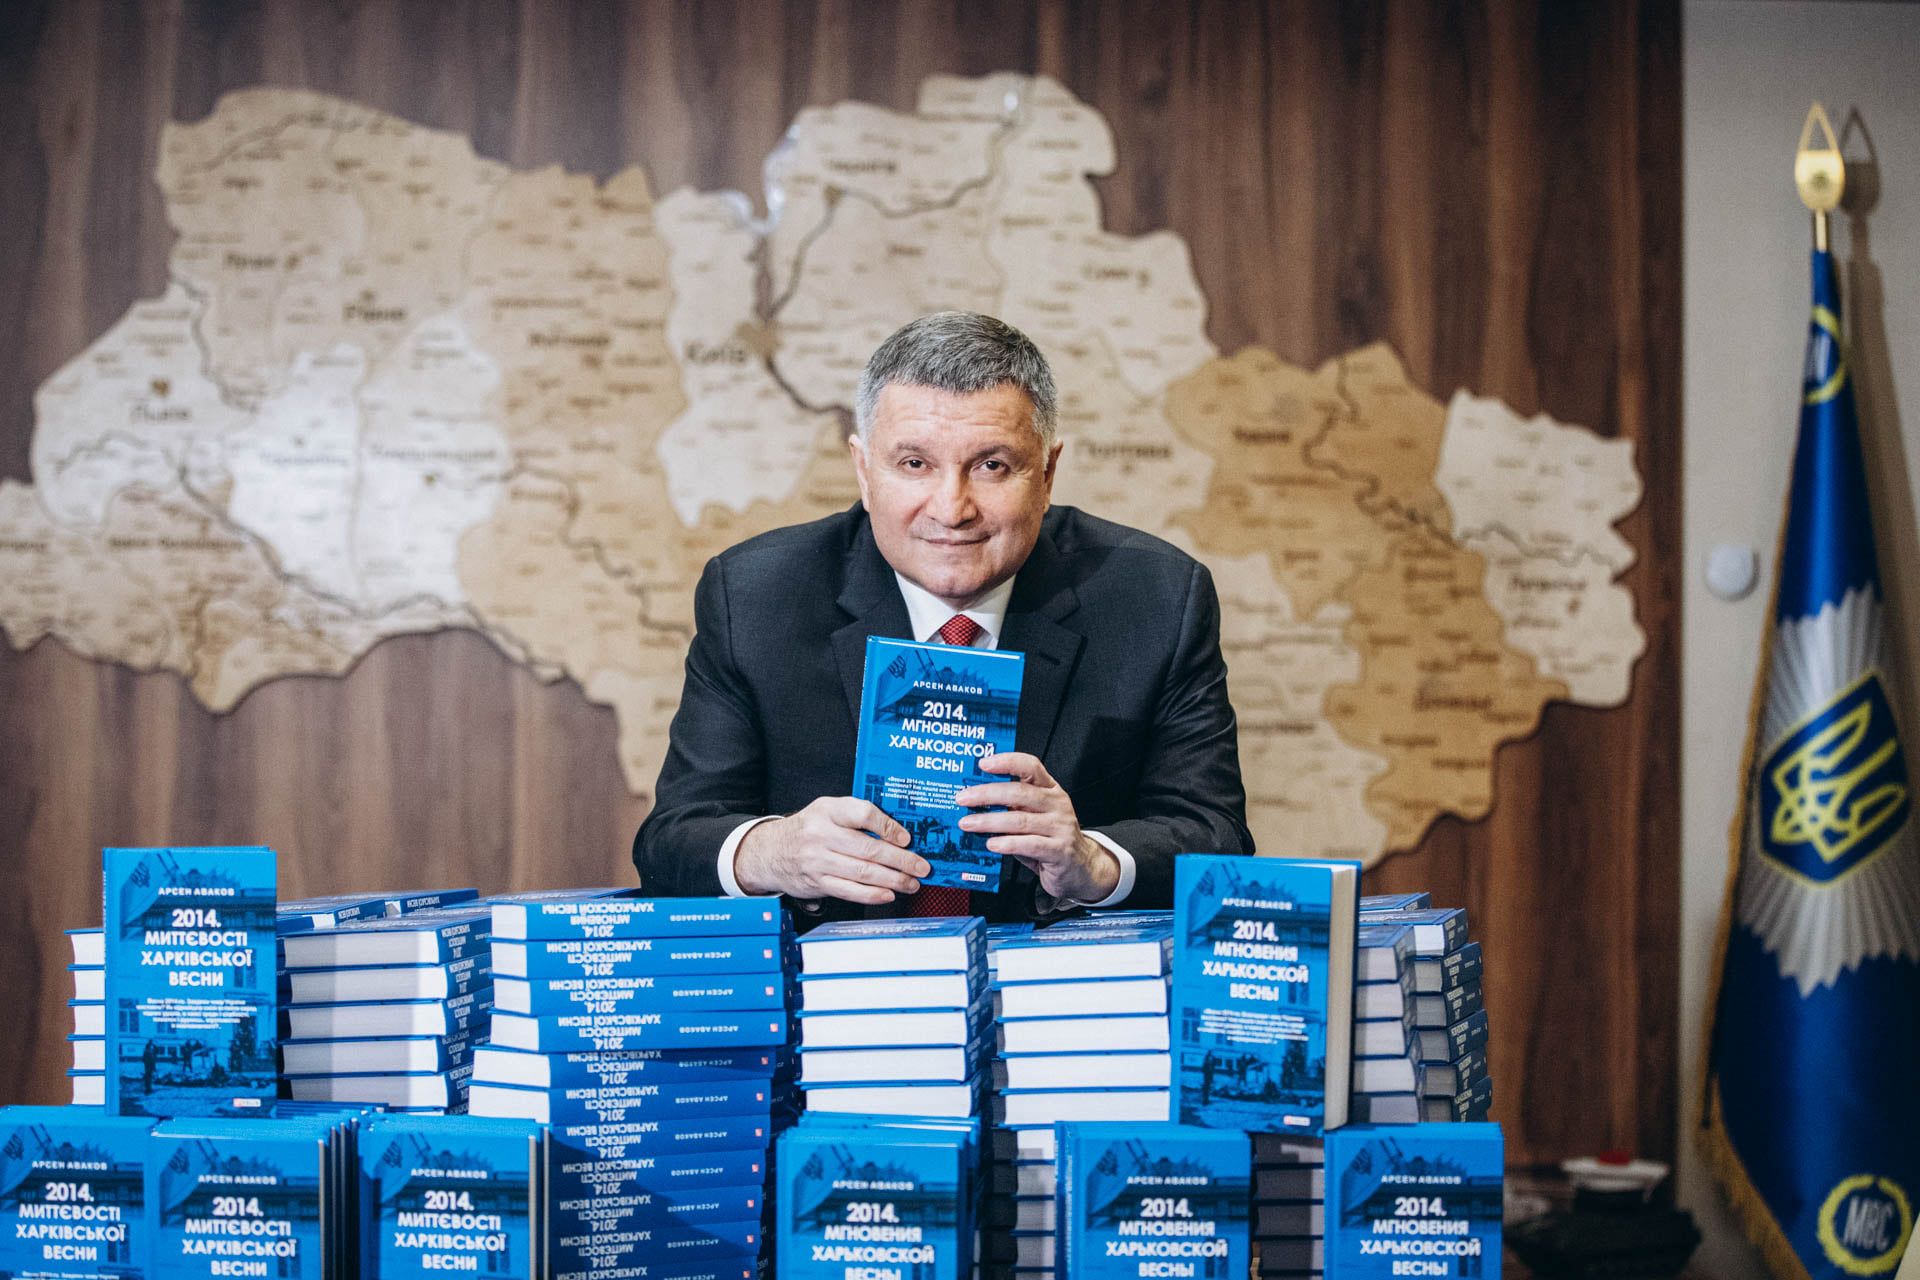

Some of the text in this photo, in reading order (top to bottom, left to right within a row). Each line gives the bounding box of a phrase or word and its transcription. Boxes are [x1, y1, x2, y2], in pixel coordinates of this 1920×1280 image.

[913, 681, 982, 694] АРСЕН АВАКОВ
[923, 701, 967, 721] 2014.
[902, 718, 985, 740] МГНОВЕНИЯ
[889, 735, 995, 758] ХАРЬКОВСКОЙ
[916, 756, 964, 773] ВЕСНЫ
[158, 887, 234, 896] АРСЕН АВАКОВ
[172, 909, 221, 927] 2014.
[582, 925, 614, 937] 2014.
[1233, 920, 1279, 941] 2014.
[145, 931, 247, 946] МИТТЄВОСТІ
[141, 949, 252, 966] ХАРКІВСЬКОЇ
[582, 963, 614, 976] 2014.
[169, 971, 223, 986] ВЕСНИ
[584, 1000, 616, 1013] 2014.
[593, 1037, 624, 1050] 2014.
[600, 1072, 628, 1084] 2014.
[598, 1109, 625, 1121] 2014.
[598, 1146, 626, 1158] 2014.
[32, 1161, 107, 1170] АРСЕН АВАКОВ
[562, 1159, 655, 1173] ХАРКІВСЬКОЇ ВЕСНИ
[198, 1175, 276, 1185] АРСЕН АВАКОВ
[411, 1169, 487, 1179] АРСЕН АВАКОВ
[581, 1171, 637, 1183] МИТТЄВОСТІ
[1127, 1176, 1208, 1185] АРСЕН АВАКОВ
[1381, 1175, 1461, 1184] АРСЕН АВАКОВ
[45, 1182, 94, 1201] 2014.
[593, 1183, 621, 1194] 2014.
[213, 1197, 264, 1216] 2014.
[424, 1190, 474, 1210] 2014.
[560, 1195, 650, 1210] ХАРКІВСЬКОЇ ВЕСНИ
[1141, 1198, 1193, 1217] 2014.
[1395, 1197, 1447, 1216] 2014.
[19, 1204, 120, 1221] МИТТЄВОСТІ
[578, 1207, 634, 1220] МИТТЄВОСТІ
[846, 1203, 899, 1223] 2014.
[185, 1219, 291, 1236] МИТТЄВОСТІ
[398, 1212, 501, 1230] МИТТЄВОСТІ
[590, 1219, 617, 1231] 2014.
[1119, 1221, 1215, 1236] МГНОВЕНИЯ
[1373, 1220, 1468, 1235] МГНОВЕНИЯ
[16, 1224, 125, 1241] ХАРКІВСЬКОЇ
[560, 1231, 650, 1247] ХАРКІВСЬКОЇ ВЕСНИ
[824, 1225, 922, 1242] МГНОВЕНИЯ
[182, 1239, 296, 1257] ХАРКІВСЬКОЇ
[395, 1233, 506, 1251] ХАРКІВСЬКОЇ
[1106, 1239, 1227, 1257] ХАРЬКОВСКОЙ
[1360, 1238, 1481, 1256] ХАРЬКОВСКОЙ
[43, 1245, 97, 1260] ВЕСНИ
[578, 1244, 634, 1256] МИТТЄВОСТІ
[812, 1245, 934, 1263] ХАРЬКОВСКОЙ
[211, 1261, 267, 1276] ВЕСНИ
[422, 1254, 477, 1270] ВЕСНИ
[590, 1255, 617, 1268] 2014.
[1393, 1261, 1448, 1275] ВЕСНЫ
[845, 1268, 901, 1280] ВЕСНЫ
[1139, 1262, 1194, 1277] ВЕСНЫ
